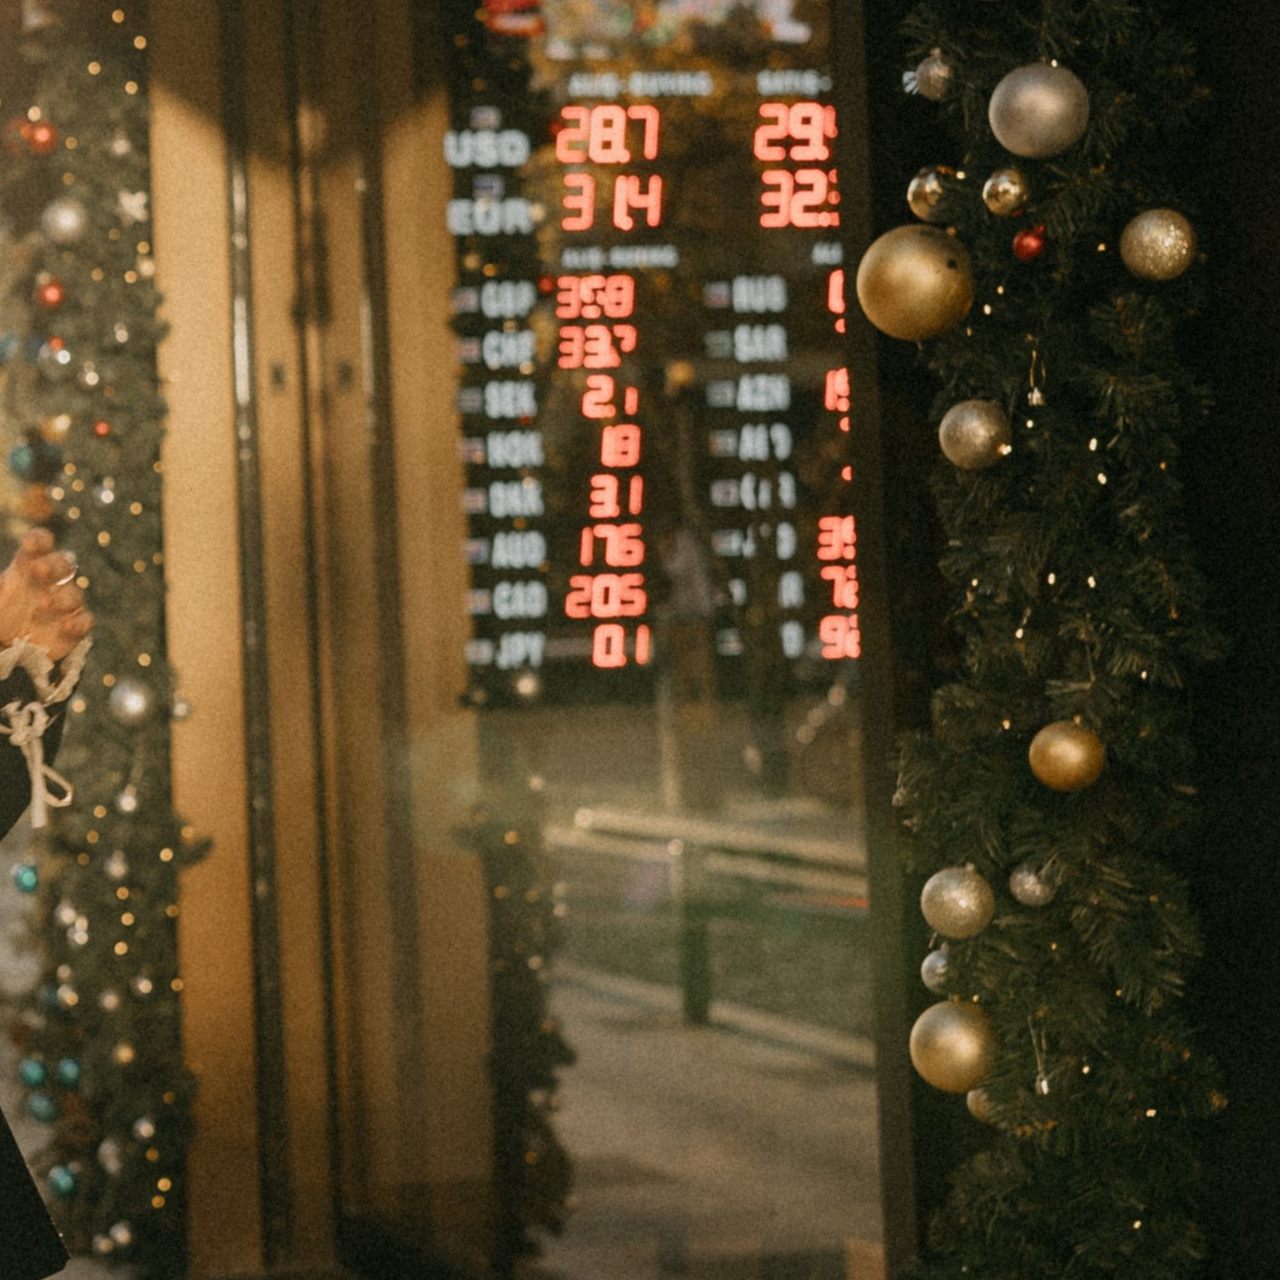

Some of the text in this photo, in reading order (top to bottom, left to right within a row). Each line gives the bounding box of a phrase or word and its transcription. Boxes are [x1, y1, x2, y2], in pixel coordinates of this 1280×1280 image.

[443, 128, 529, 167] USD
[447, 199, 531, 233] EUR
[760, 169, 839, 227] 32.
[484, 382, 536, 418] SEK
[493, 532, 545, 568] AUD
[493, 582, 547, 618] CAD
[496, 633, 545, 668] JPY
